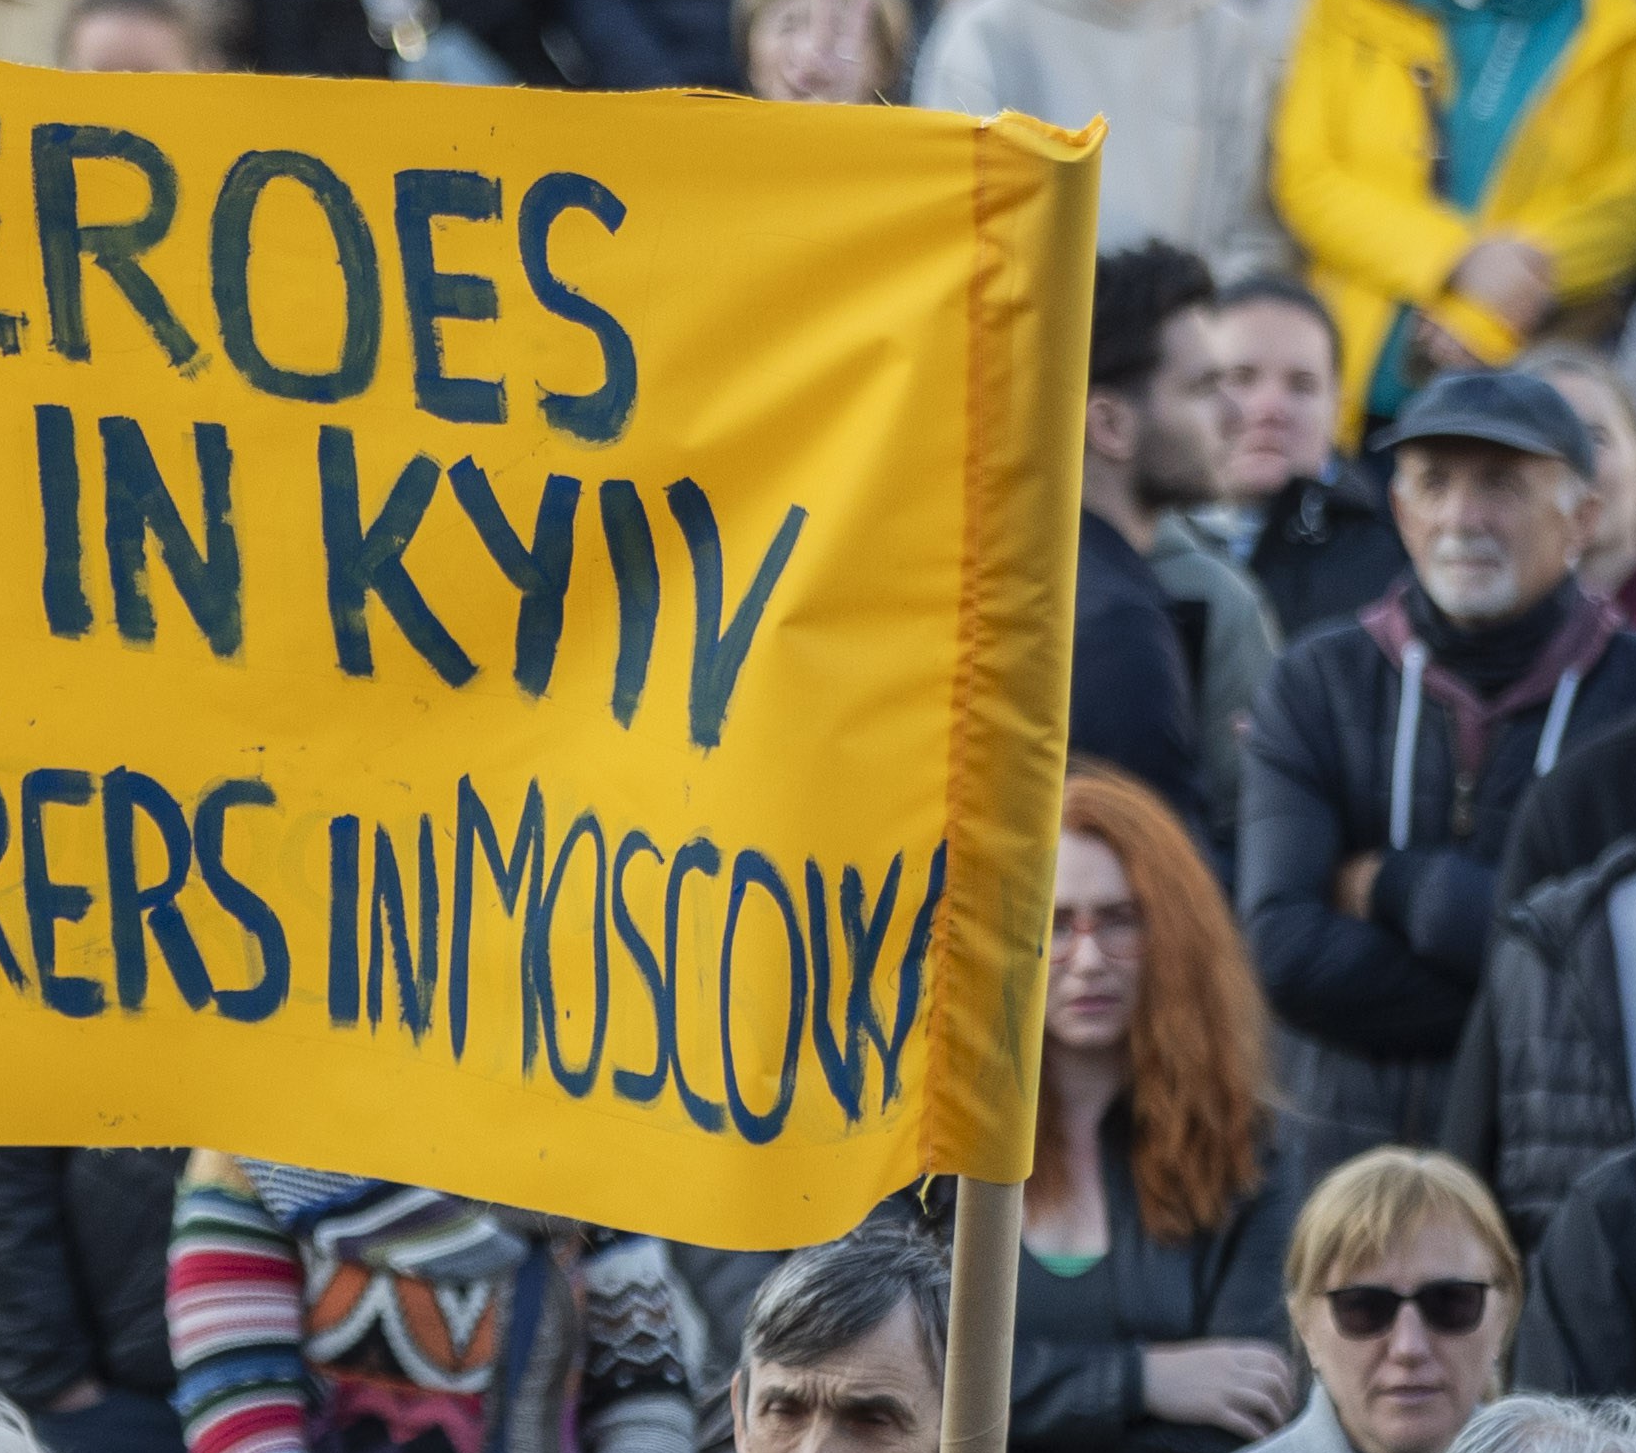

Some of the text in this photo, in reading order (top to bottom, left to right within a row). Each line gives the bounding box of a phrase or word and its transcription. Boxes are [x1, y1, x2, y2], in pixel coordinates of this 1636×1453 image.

[34, 404, 242, 657] IN
[318, 425, 806, 749] KYIV
[329, 814, 439, 1041] IN
[449, 774, 948, 1144] MOSCOW
